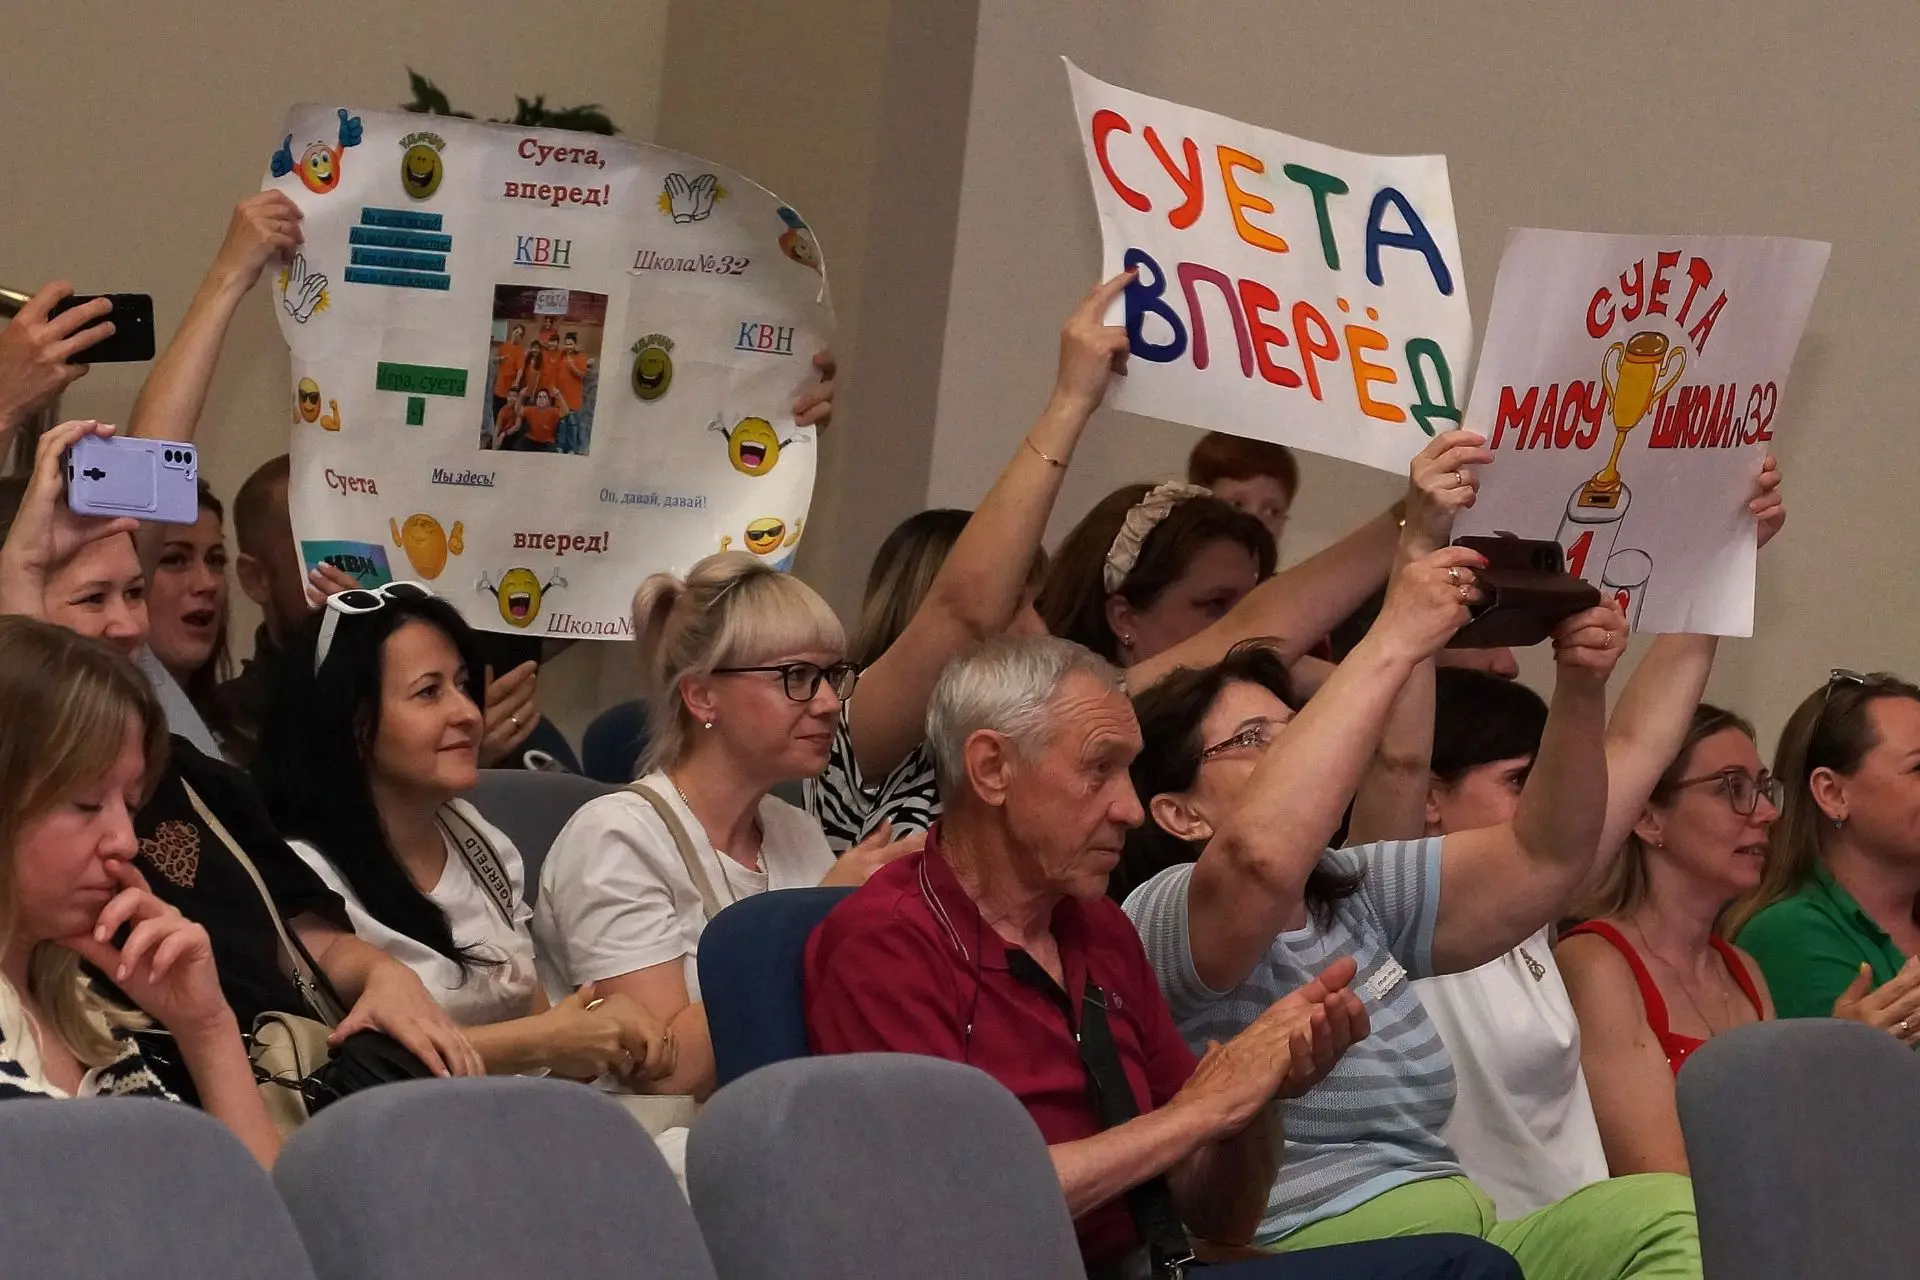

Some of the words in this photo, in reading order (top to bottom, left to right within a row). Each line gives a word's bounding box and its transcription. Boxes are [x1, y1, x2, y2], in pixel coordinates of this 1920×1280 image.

[517, 138, 606, 169] Суета,
[504, 182, 611, 207] вперед!
[1091, 108, 1454, 296] СУЕТА
[514, 235, 572, 266] КВН
[1585, 249, 1729, 356] СУЕТА
[736, 322, 795, 354] КВН
[1123, 247, 1463, 437] ВПЕРЁД
[1490, 380, 1607, 450] МАОУ
[324, 468, 379, 496] Суета
[431, 468, 453, 484] Мы
[455, 469, 496, 486] здесь!
[620, 492, 661, 507] давай,
[663, 495, 707, 509] давай!
[513, 531, 610, 556] вперед!
[1566, 530, 1595, 579] 1
